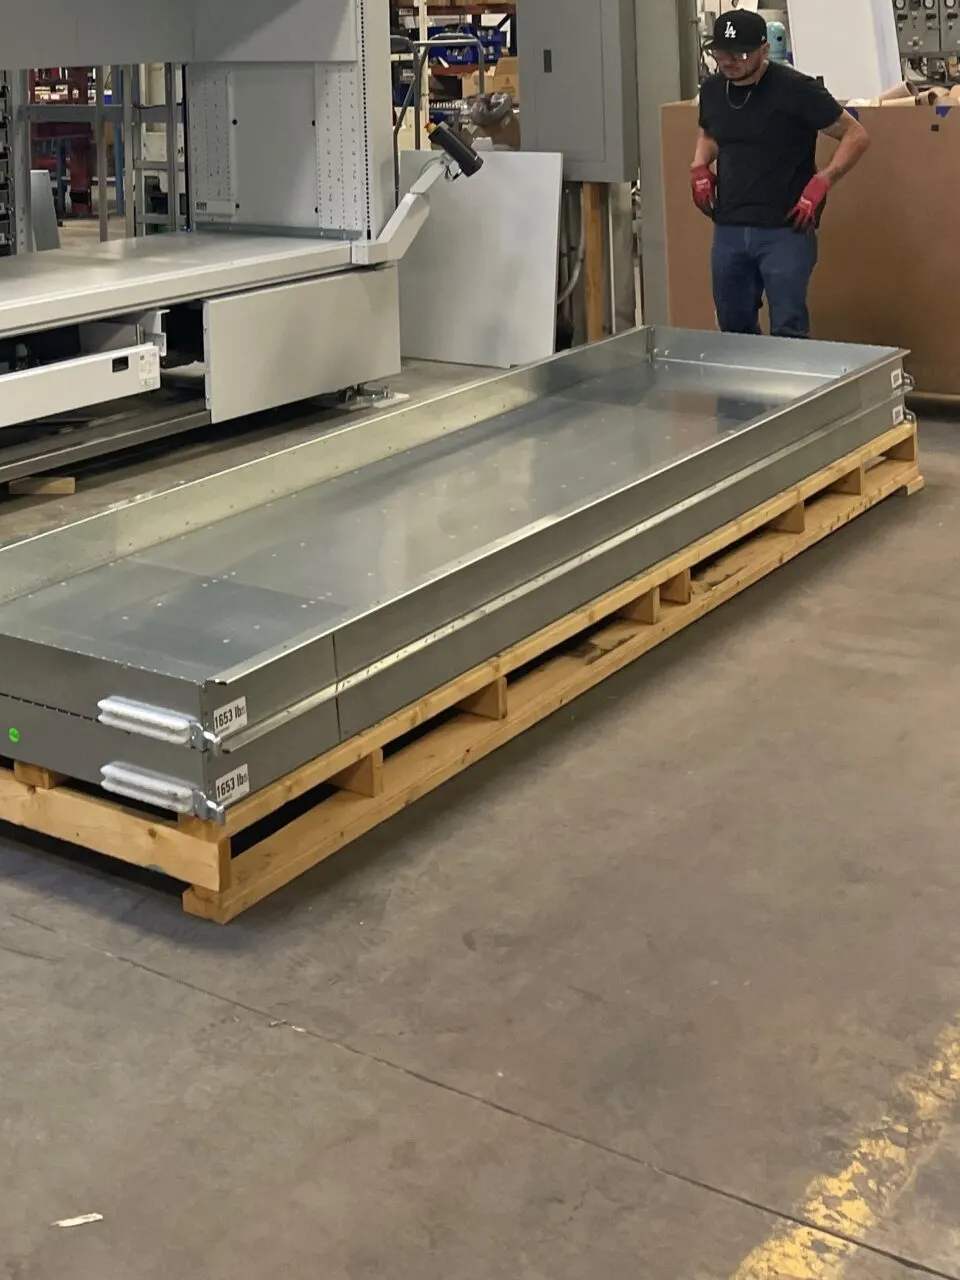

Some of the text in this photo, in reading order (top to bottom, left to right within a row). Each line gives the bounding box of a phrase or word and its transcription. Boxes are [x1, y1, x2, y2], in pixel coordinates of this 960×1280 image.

[724, 21, 737, 38] LA
[214, 709, 233, 729] 1653
[216, 777, 235, 798] 1653
